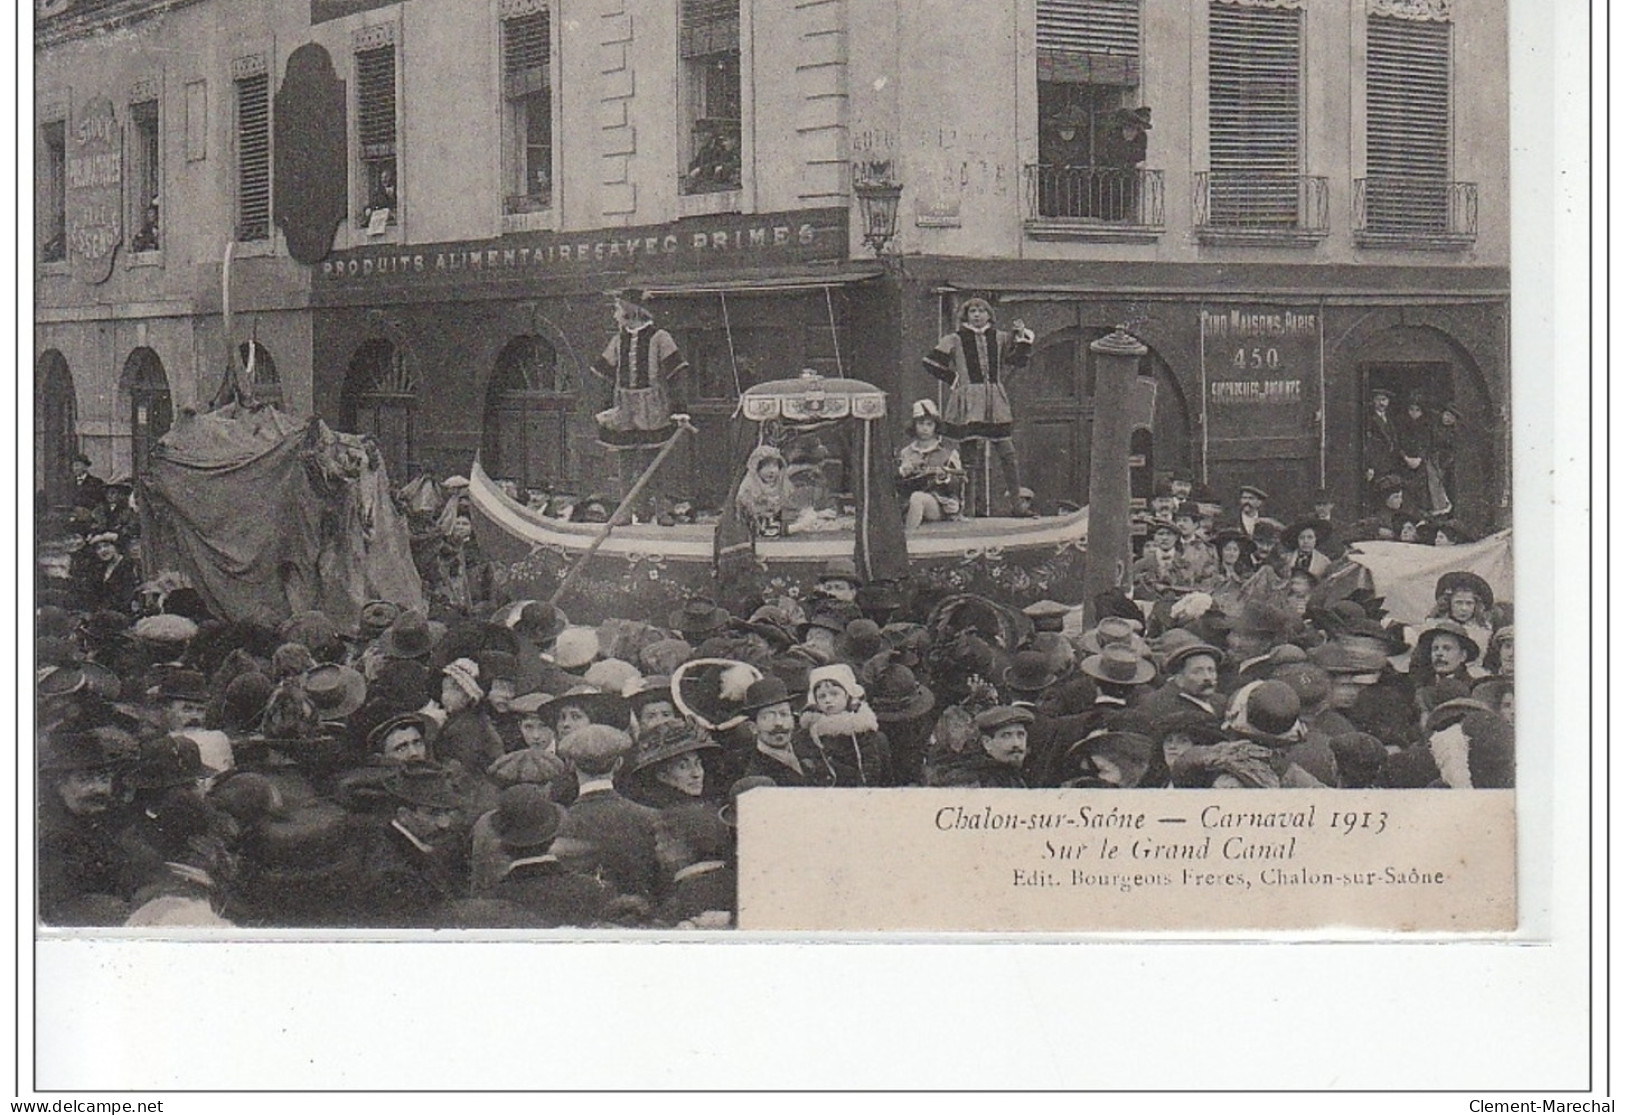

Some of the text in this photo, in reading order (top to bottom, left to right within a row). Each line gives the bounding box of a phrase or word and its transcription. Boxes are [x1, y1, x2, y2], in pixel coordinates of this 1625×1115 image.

[323, 254, 425, 276] PRODUITS
[436, 243, 604, 269] ALIMENTAIRES
[609, 233, 678, 257] AVEC
